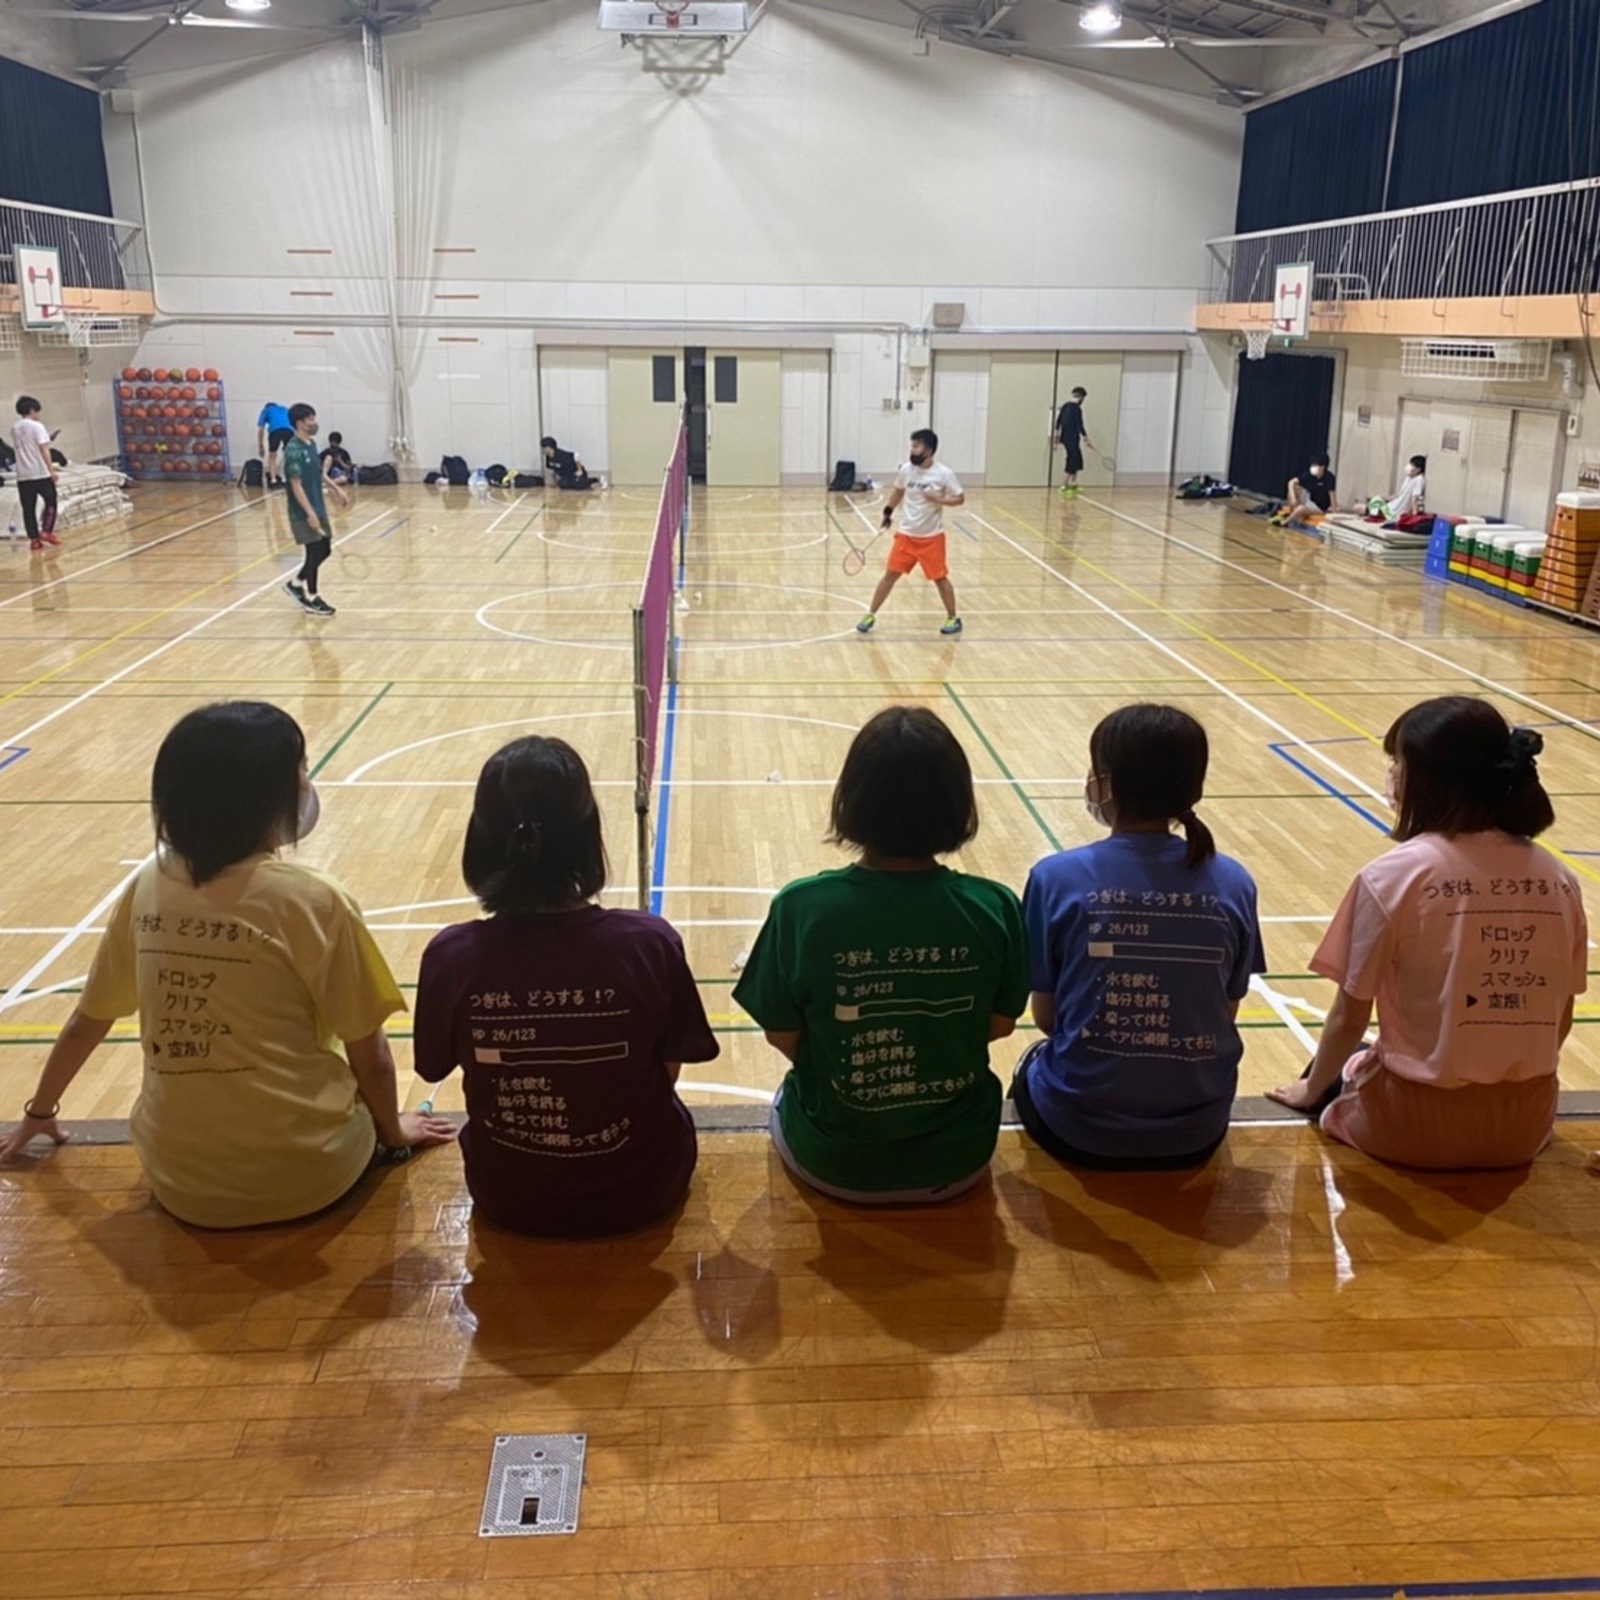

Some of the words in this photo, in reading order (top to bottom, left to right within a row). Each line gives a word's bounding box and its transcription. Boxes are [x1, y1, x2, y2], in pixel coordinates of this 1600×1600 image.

[1107, 923, 1150, 936] 26/123
[1480, 924, 1537, 943] ドロップ
[1489, 946, 1531, 965] クリア
[158, 968, 217, 990] ドロップ
[1480, 970, 1547, 988] スマッシュ
[165, 991, 208, 1013] クリア
[159, 1018, 233, 1036] スマッシュ
[491, 1028, 537, 1042] 26/123
